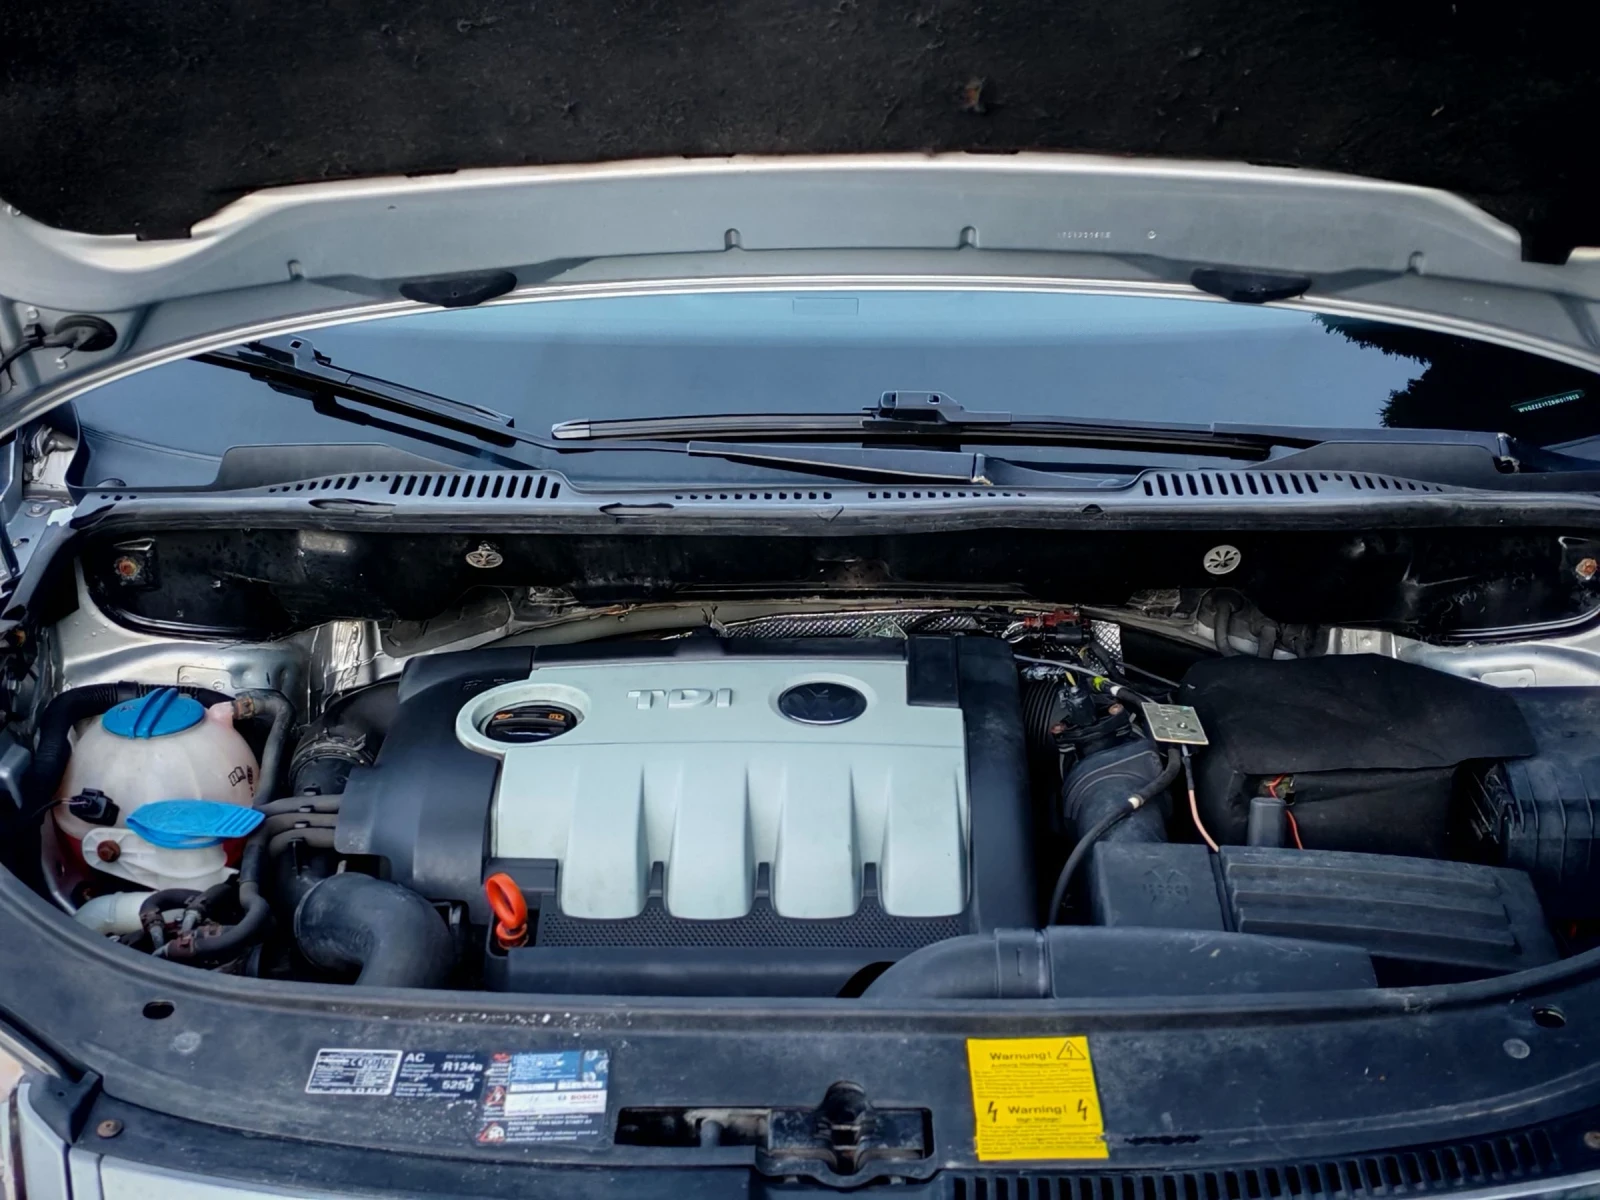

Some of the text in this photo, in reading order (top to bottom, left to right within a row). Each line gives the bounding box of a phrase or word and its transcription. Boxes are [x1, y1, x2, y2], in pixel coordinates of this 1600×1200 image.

[626, 688, 733, 710] TDI
[404, 1052, 426, 1063] AC
[989, 1050, 1052, 1062] Warnung!
[441, 1061, 483, 1072] R134a
[569, 1093, 599, 1101] BOSCH
[1007, 1103, 1067, 1115] Warning!
